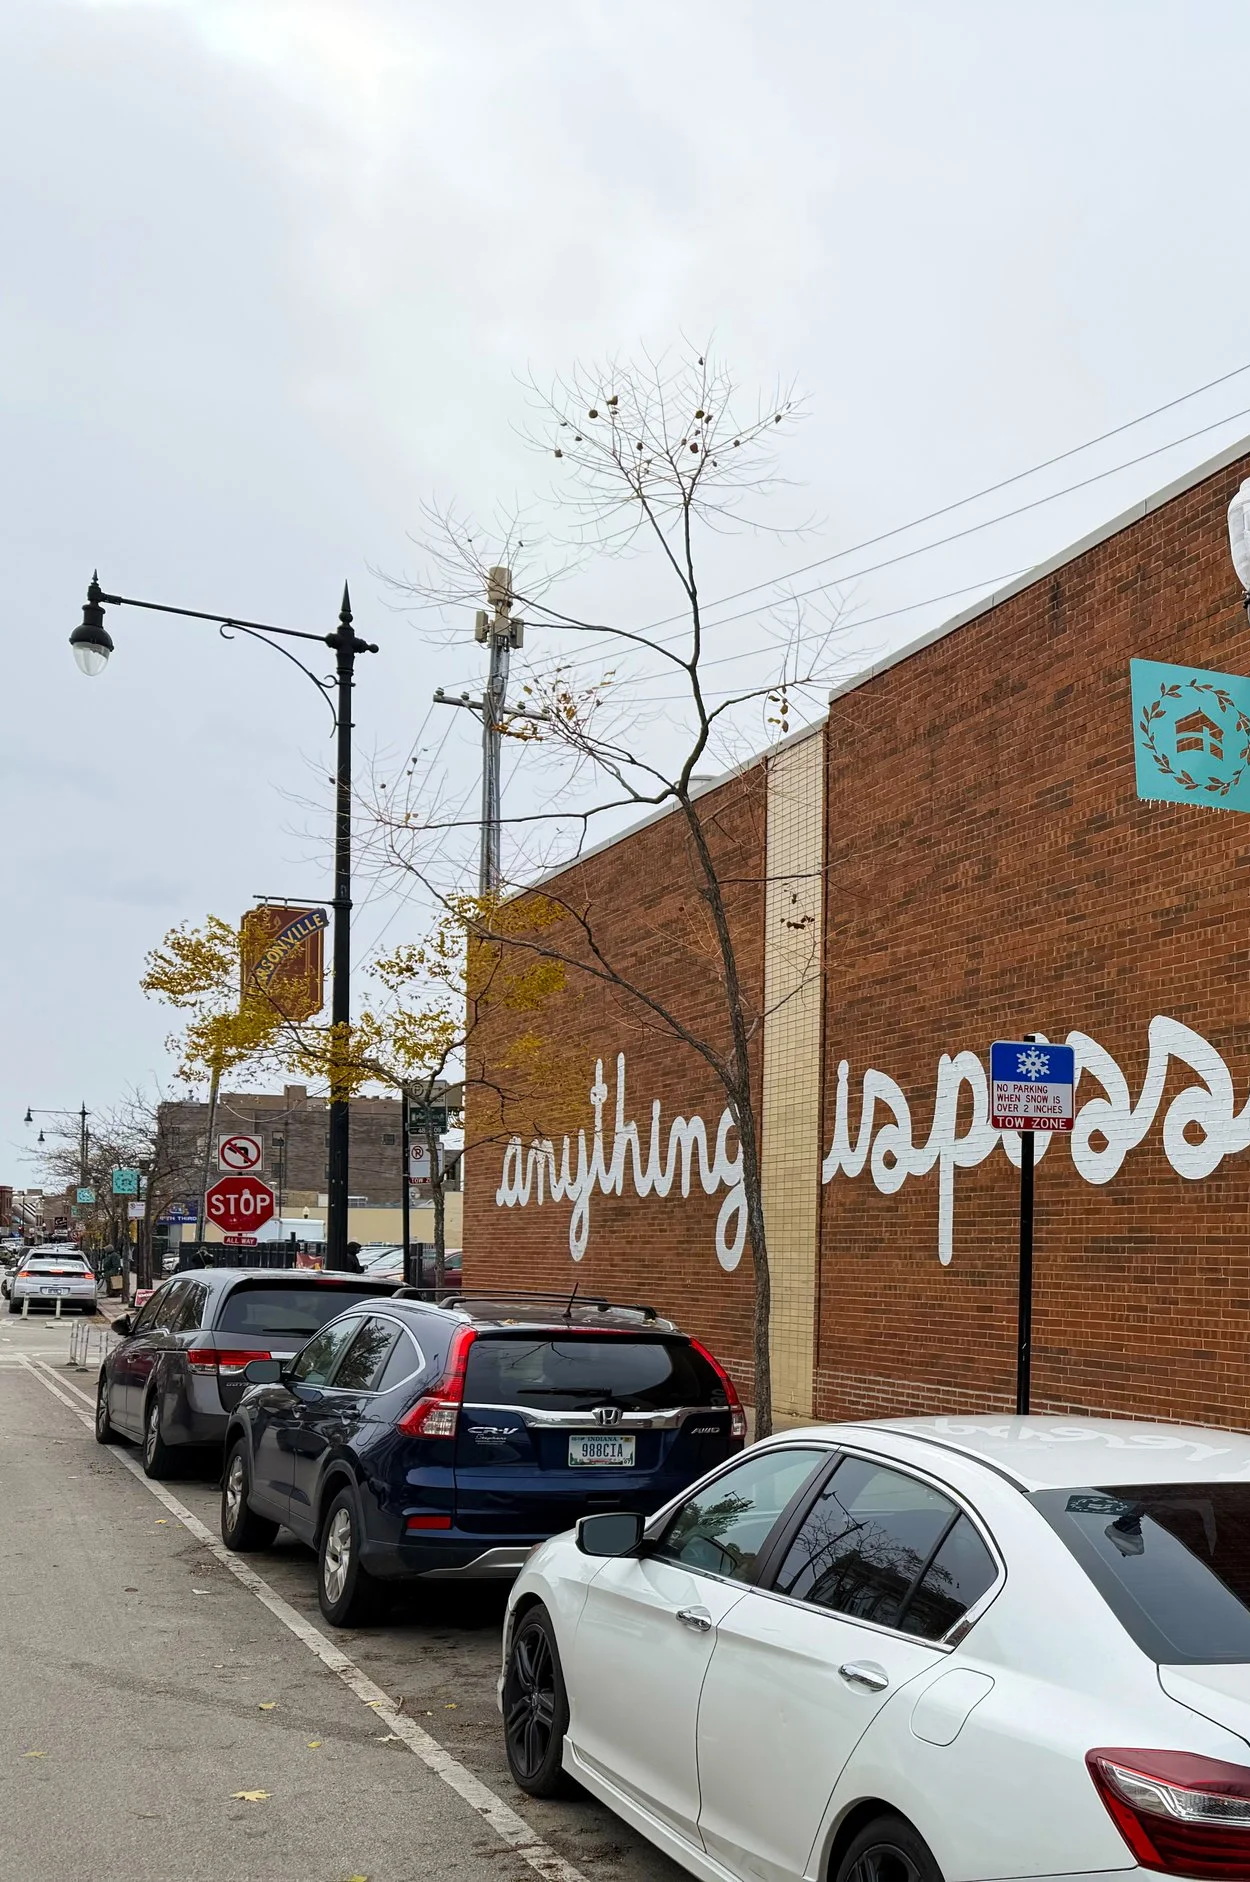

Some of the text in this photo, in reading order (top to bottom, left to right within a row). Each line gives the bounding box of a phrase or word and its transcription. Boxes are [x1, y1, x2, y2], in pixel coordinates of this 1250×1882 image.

[996, 1083, 1048, 1094] NO PARKING
[996, 1094, 1061, 1104] WHEN SNOW IS
[996, 1104, 1063, 1114] OVER 2 INCHES
[997, 1117, 1067, 1129] TOW ZONE
[495, 1052, 748, 1272] anything
[210, 1193, 270, 1216] STOP
[467, 1426, 519, 1435] CR-V
[582, 1443, 623, 1457] 988CIA
